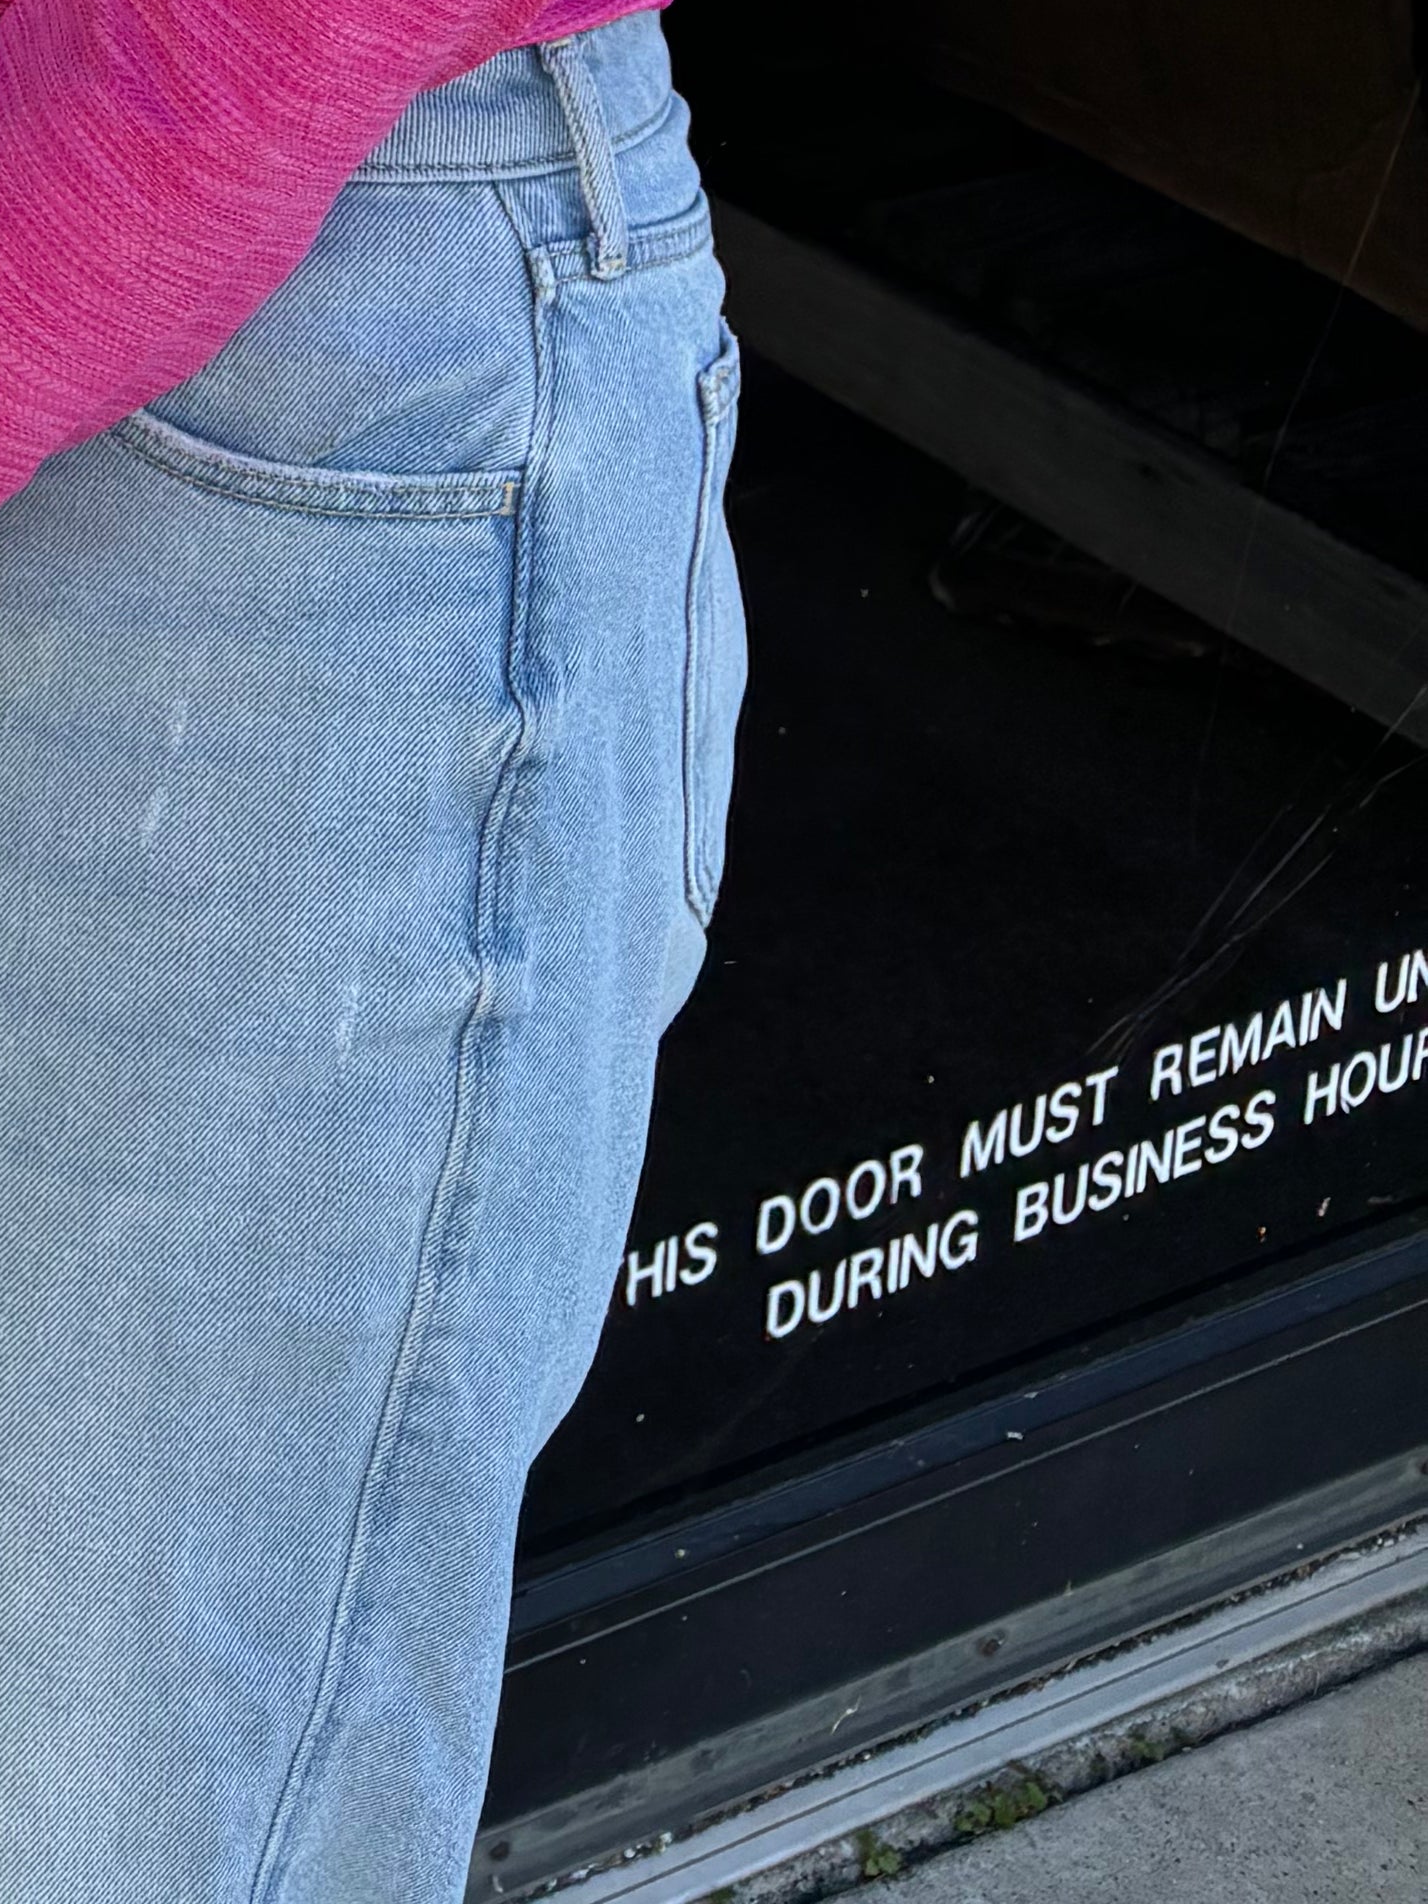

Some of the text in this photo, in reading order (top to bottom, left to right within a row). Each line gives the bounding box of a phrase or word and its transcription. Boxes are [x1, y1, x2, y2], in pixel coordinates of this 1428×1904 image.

[620, 1223, 718, 1306] HIS
[756, 1144, 923, 1255] DOOR
[960, 1066, 1119, 1177] MUST
[1150, 979, 1346, 1101] REMAIN
[766, 1210, 979, 1338] DURING
[1015, 1091, 1275, 1243] BUSINESS
